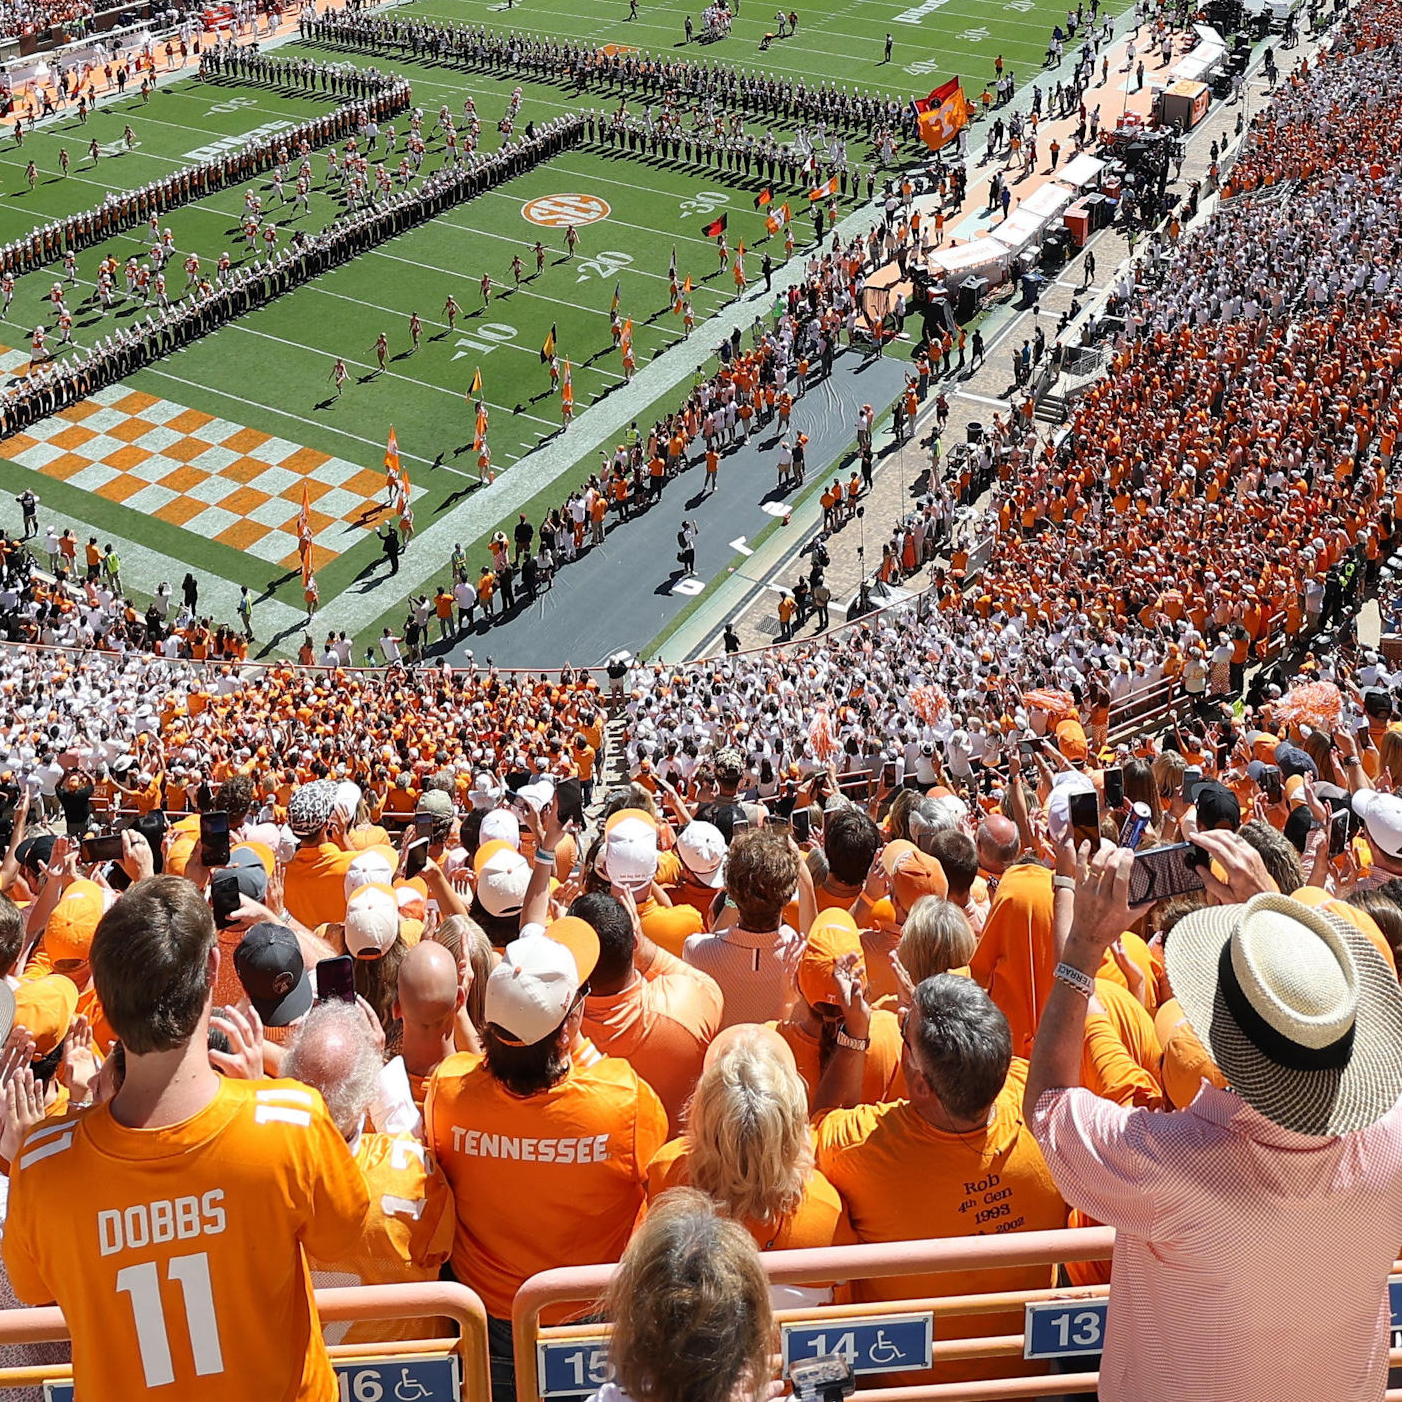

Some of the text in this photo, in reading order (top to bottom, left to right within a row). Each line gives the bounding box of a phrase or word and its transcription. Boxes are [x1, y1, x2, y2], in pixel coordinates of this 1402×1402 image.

[679, 192, 730, 213] 30
[577, 251, 634, 279] 20
[454, 323, 518, 356] 10
[451, 1126, 609, 1164] TENNESSEE
[958, 1186, 1013, 1214] 4th Gen
[964, 1174, 1000, 1196] Rob
[98, 1188, 226, 1256] DOBBS
[996, 1216, 1025, 1235] 2002
[115, 1252, 225, 1388] 11
[1050, 1312, 1101, 1346] 13
[807, 1332, 859, 1365] 14
[563, 1348, 616, 1386] 15
[339, 1369, 384, 1402] 16
